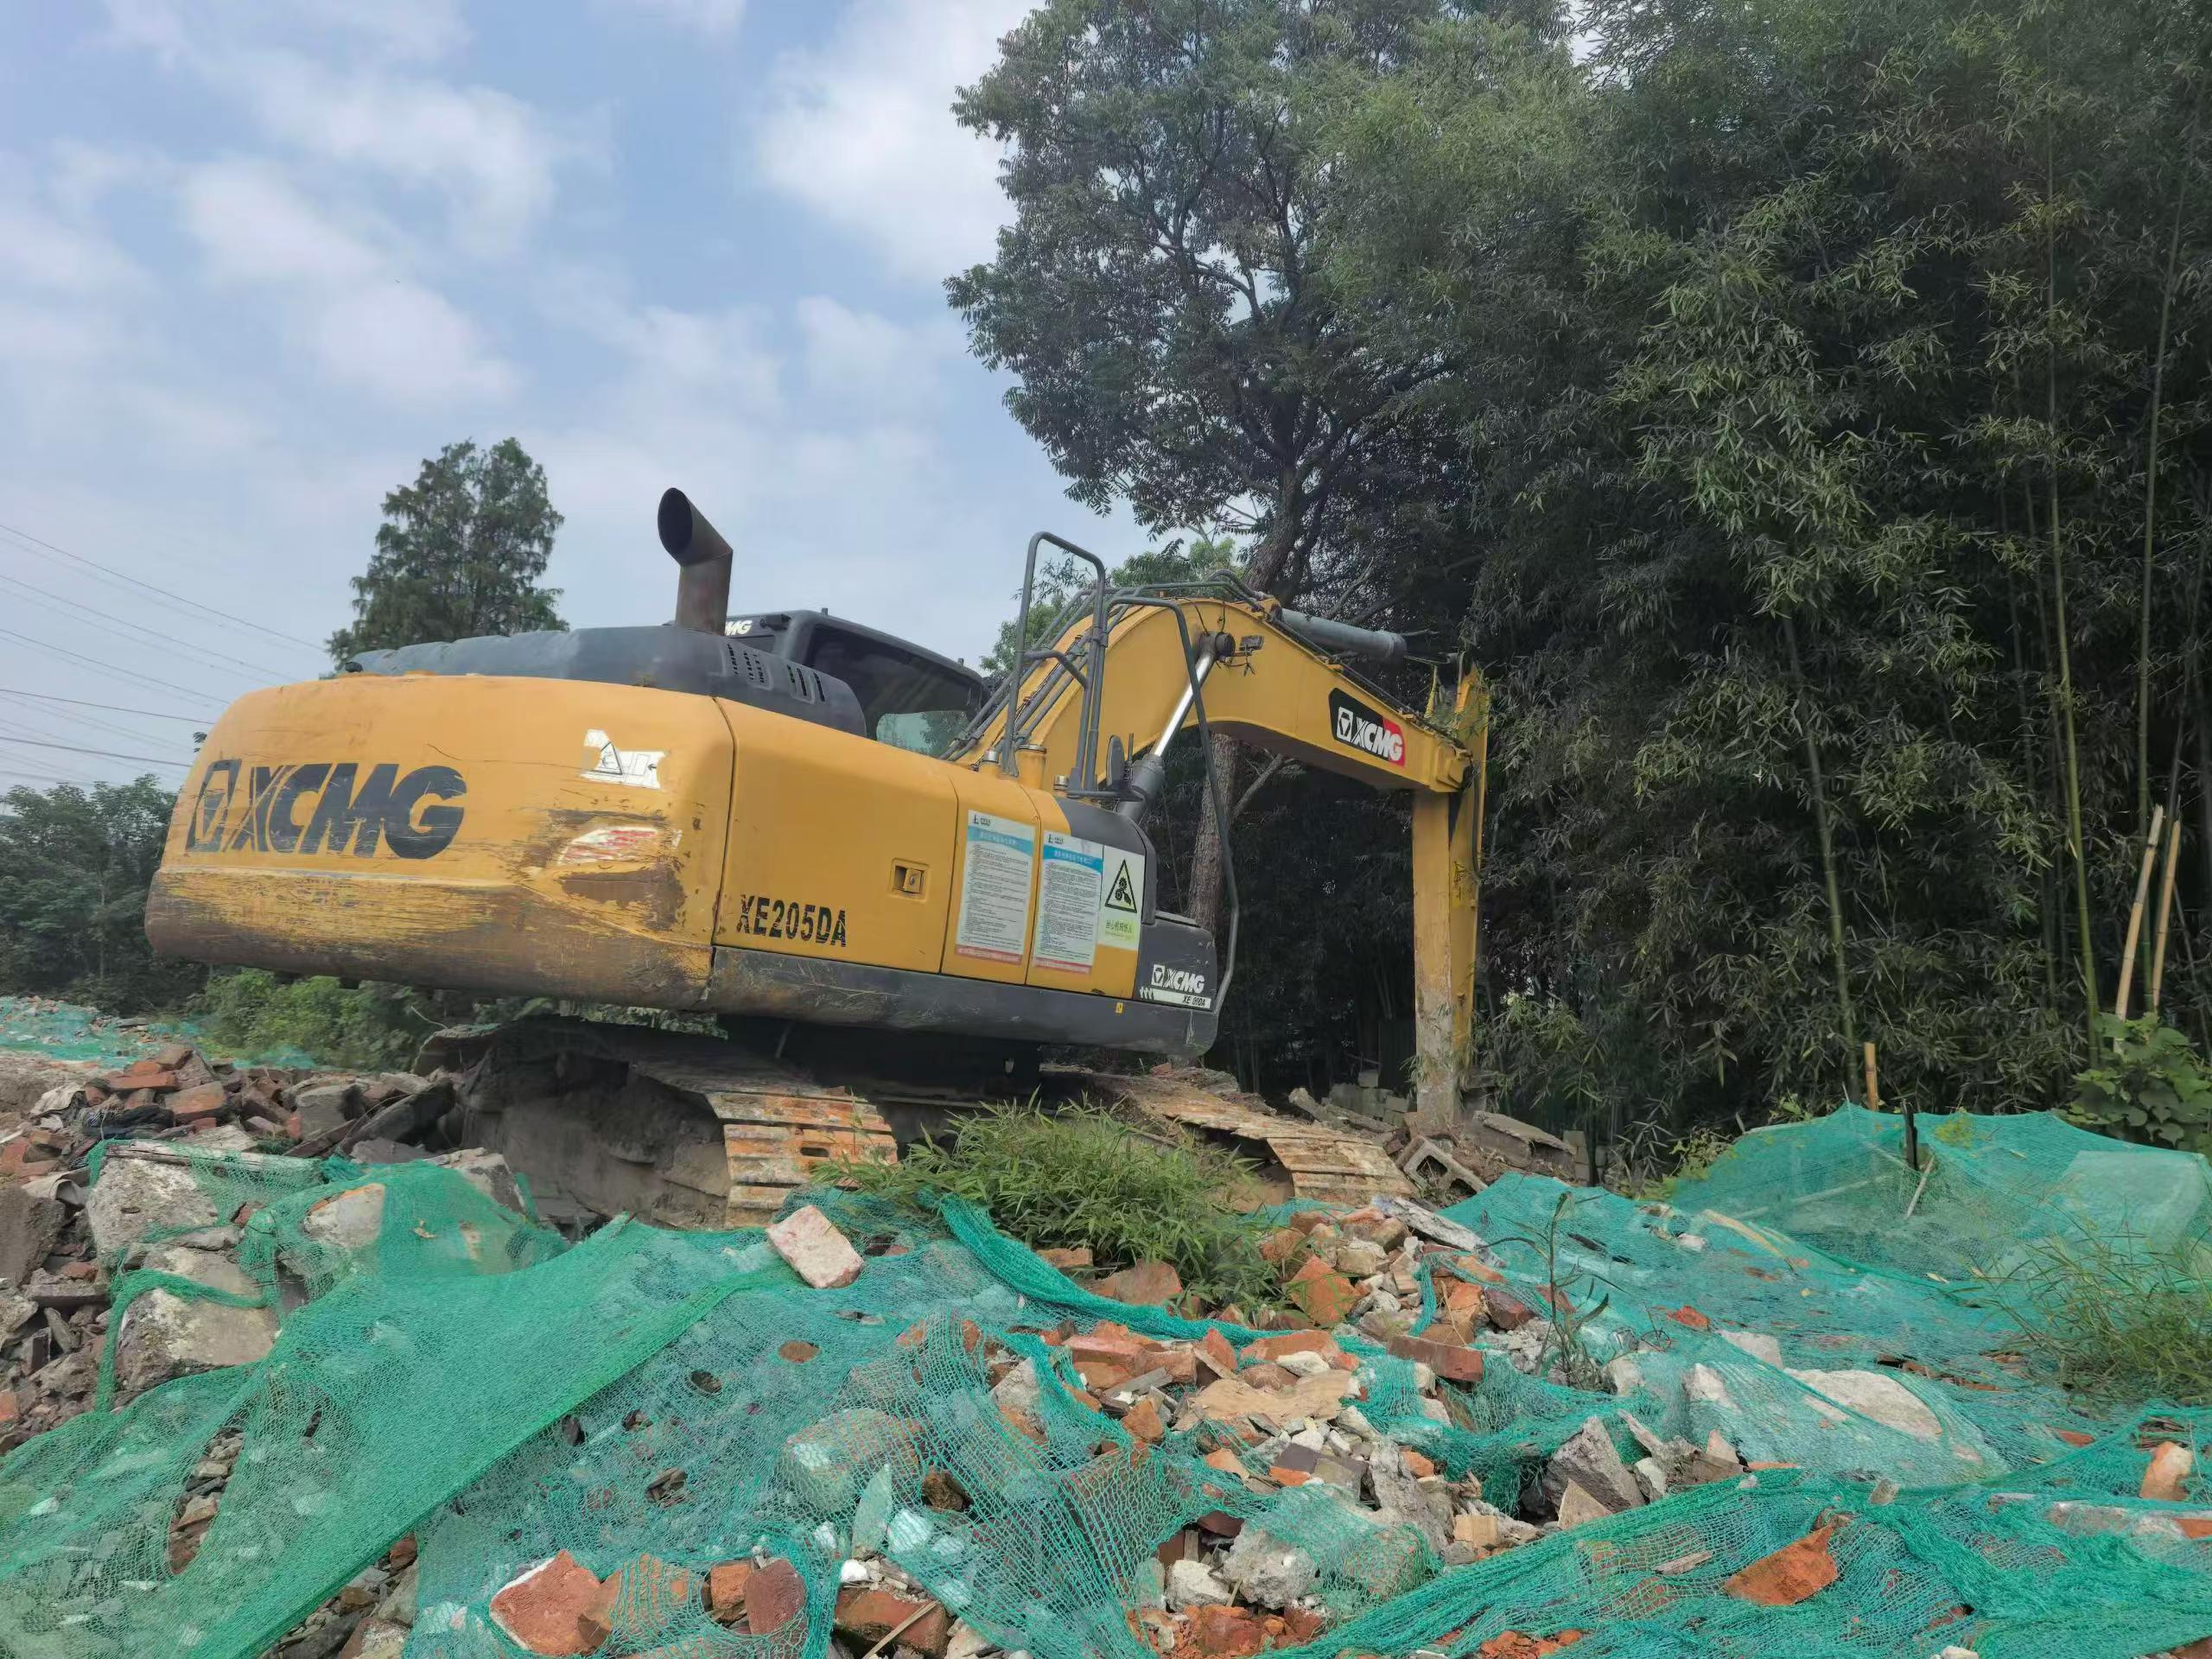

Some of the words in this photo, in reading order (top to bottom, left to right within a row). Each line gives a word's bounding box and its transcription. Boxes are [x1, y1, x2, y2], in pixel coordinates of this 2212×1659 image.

[725, 620, 753, 636] MG
[1351, 716, 1402, 761] XCMG
[221, 763, 467, 859] XCMG
[736, 894, 847, 947] XE205DA
[1163, 968, 1205, 994] XCMG
